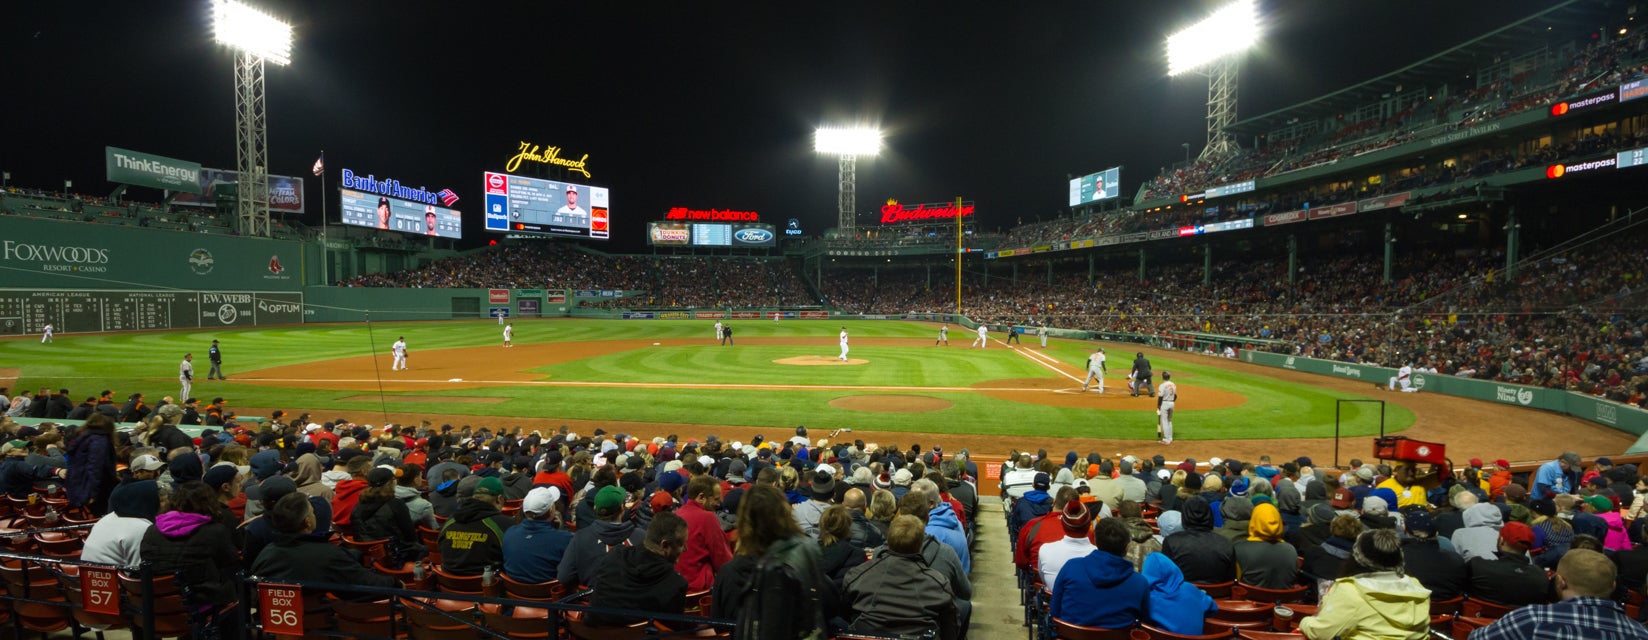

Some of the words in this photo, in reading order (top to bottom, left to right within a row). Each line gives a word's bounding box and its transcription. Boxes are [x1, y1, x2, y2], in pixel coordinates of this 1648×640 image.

[1570, 92, 1614, 110] masterpass
[506, 140, 541, 172] John
[541, 146, 591, 178] Hancock
[1565, 158, 1616, 172] masterpass
[114, 154, 198, 182] ThinkEnergy
[342, 168, 378, 193] Bank
[378, 178, 392, 196] of
[392, 180, 438, 205] America
[688, 211, 711, 220] new
[712, 209, 758, 220] balance
[880, 202, 974, 222] Budweiser
[4, 240, 109, 264] FOXWOODS
[268, 304, 300, 313] OPTUM
[446, 530, 488, 542] SPRINGFIELD
[88, 570, 112, 580] FIELD
[92, 579, 108, 588] BOX
[90, 589, 112, 606] 57
[268, 588, 296, 598] FIELD
[272, 598, 292, 606] BOX
[270, 608, 298, 626] 56
